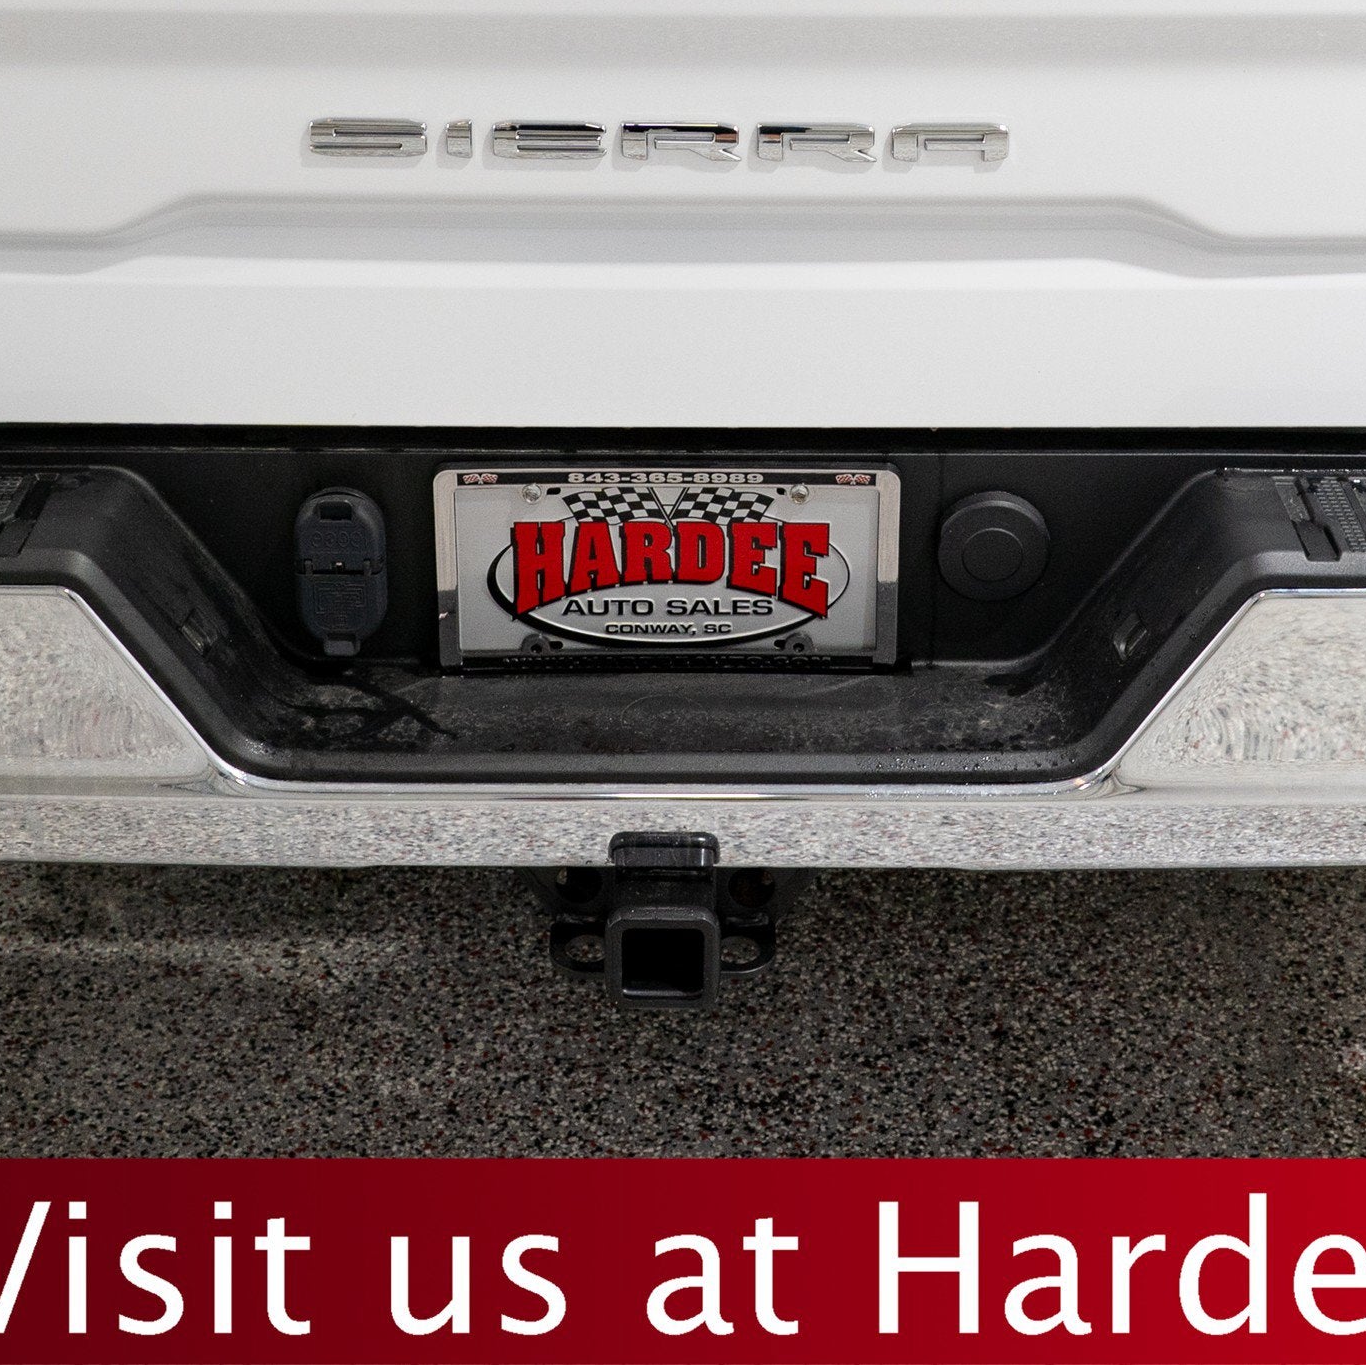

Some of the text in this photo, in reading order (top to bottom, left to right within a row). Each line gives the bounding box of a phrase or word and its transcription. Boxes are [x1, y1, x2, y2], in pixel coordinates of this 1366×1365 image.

[307, 118, 1011, 163] SIERRA
[567, 472, 764, 484] 843-365-8989
[510, 521, 831, 620] HARDEE
[561, 599, 774, 616] AUTO SALES
[604, 622, 732, 636] CONWAY, SC
